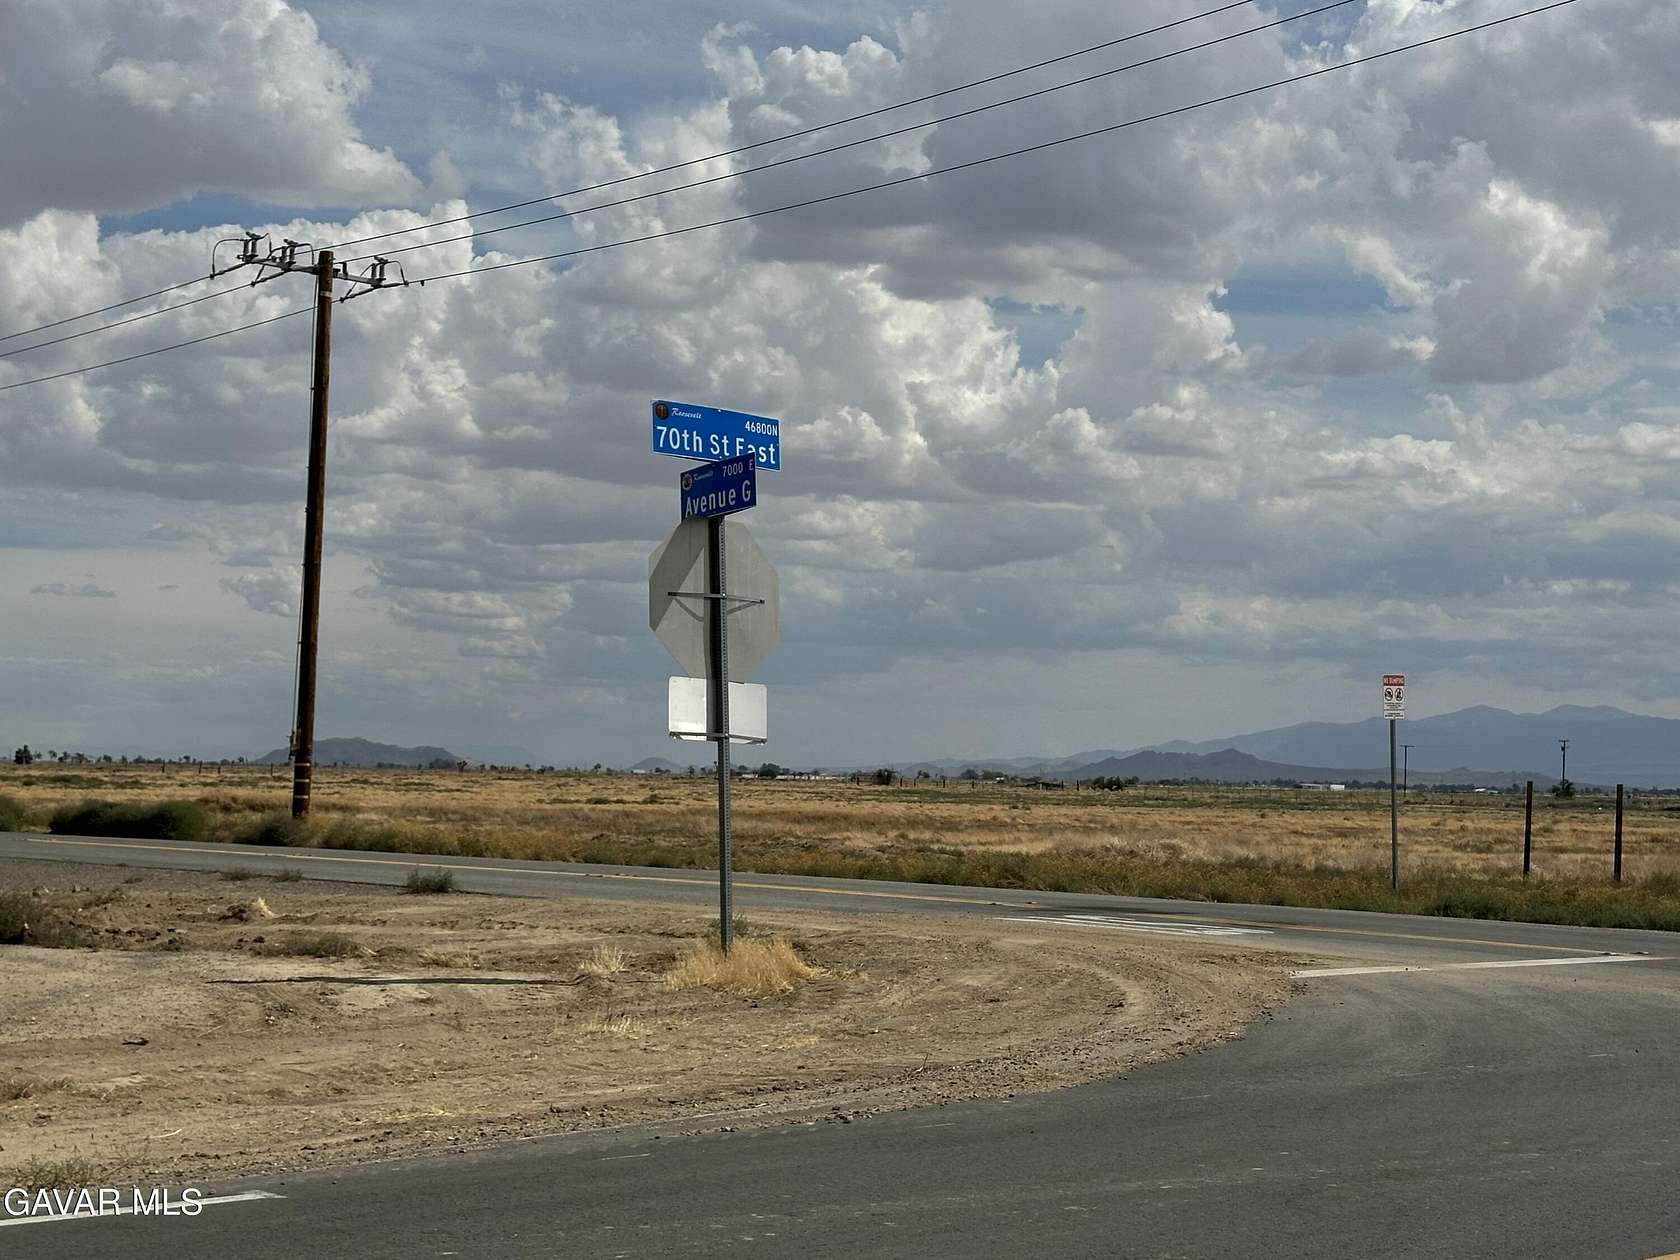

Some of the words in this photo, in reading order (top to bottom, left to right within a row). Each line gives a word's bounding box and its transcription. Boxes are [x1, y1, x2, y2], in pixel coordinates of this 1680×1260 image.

[656, 425, 703, 453] 70th
[710, 434, 730, 456] St
[744, 420, 778, 437] 46800N
[722, 462, 744, 478] 7000
[748, 459, 755, 471] E
[685, 488, 736, 518] Avenue
[741, 479, 751, 502] G
